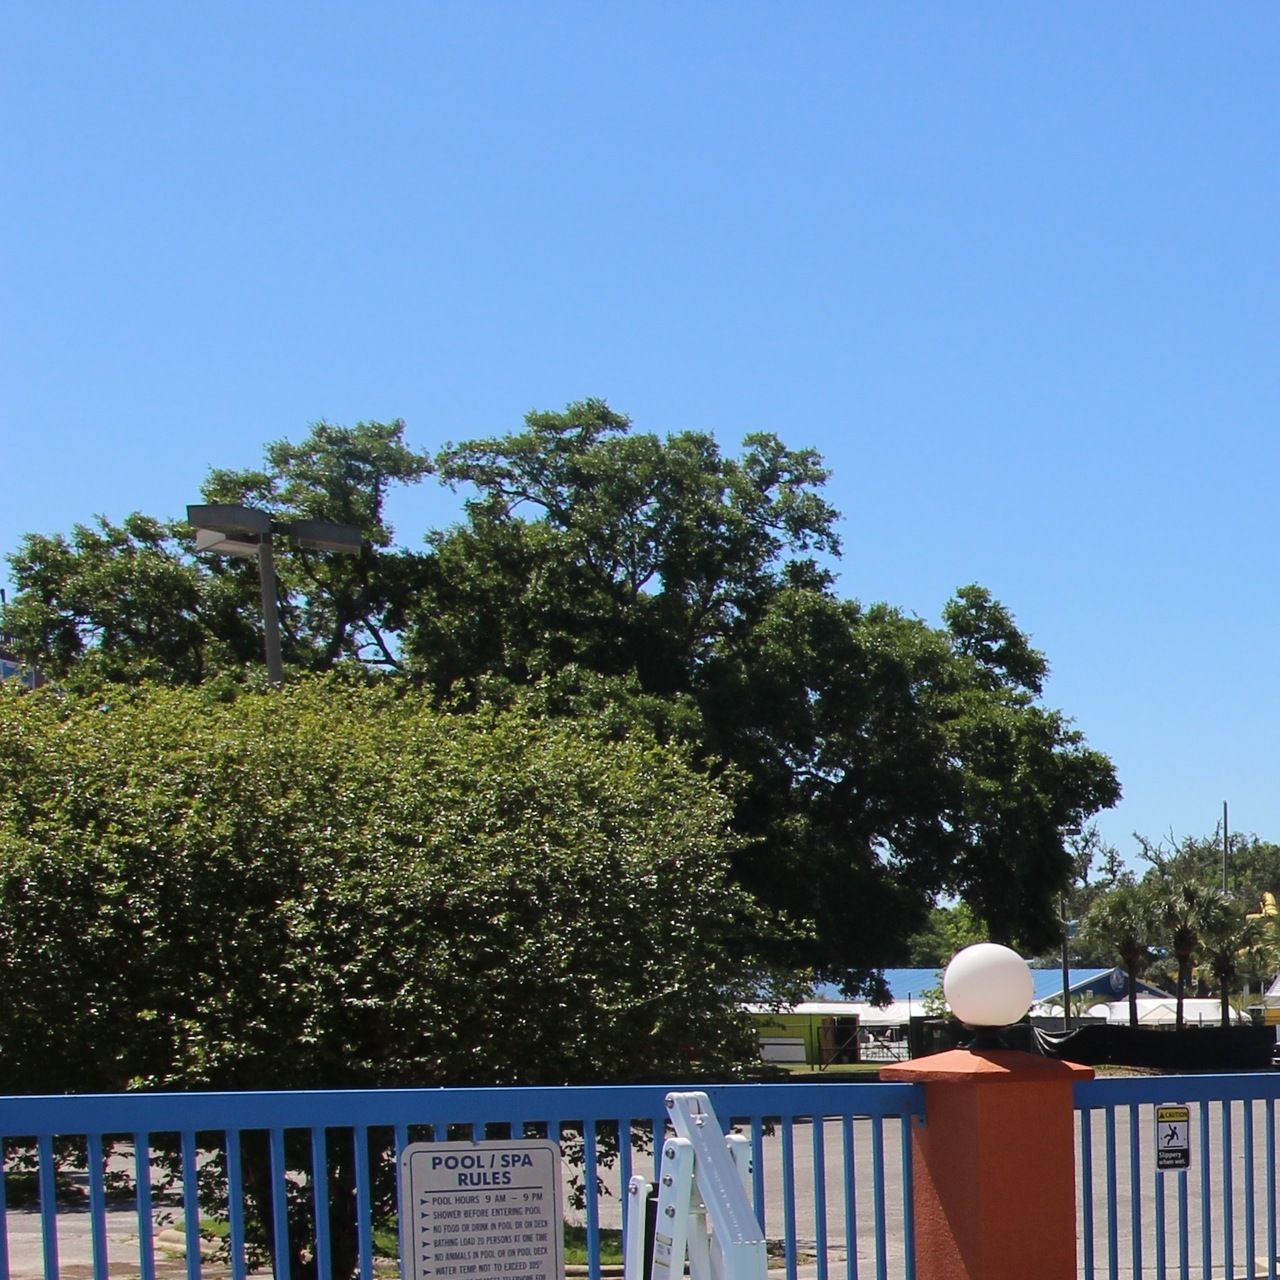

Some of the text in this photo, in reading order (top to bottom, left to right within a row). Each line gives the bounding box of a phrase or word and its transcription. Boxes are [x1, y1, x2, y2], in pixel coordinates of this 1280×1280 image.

[432, 1153, 533, 1170] POOL / SPA
[458, 1171, 512, 1186] RULES
[432, 1196, 452, 1205] POOL
[455, 1195, 480, 1204] HOURS
[485, 1195, 491, 1203] 9
[495, 1194, 506, 1202] AM
[523, 1193, 529, 1201] 9
[532, 1192, 543, 1201] PM
[433, 1206, 542, 1219] SHOWER BEFORE ENTERING POOL
[433, 1219, 548, 1233] NO FOOD OR DRINK IN POOL OR ON DECK
[433, 1237, 458, 1248] BATHING
[460, 1236, 475, 1246] LOAD
[486, 1234, 512, 1244] PERSONS
[514, 1234, 521, 1243] AT
[522, 1233, 533, 1242] ONE
[536, 1232, 548, 1241] TIME
[434, 1246, 548, 1261] NO ANIMALS IN POOL OR ON POOL DECK
[436, 1266, 456, 1275] WATER
[478, 1263, 490, 1272] NOT
[494, 1262, 502, 1271] TO
[504, 1261, 528, 1270] EXCEED
